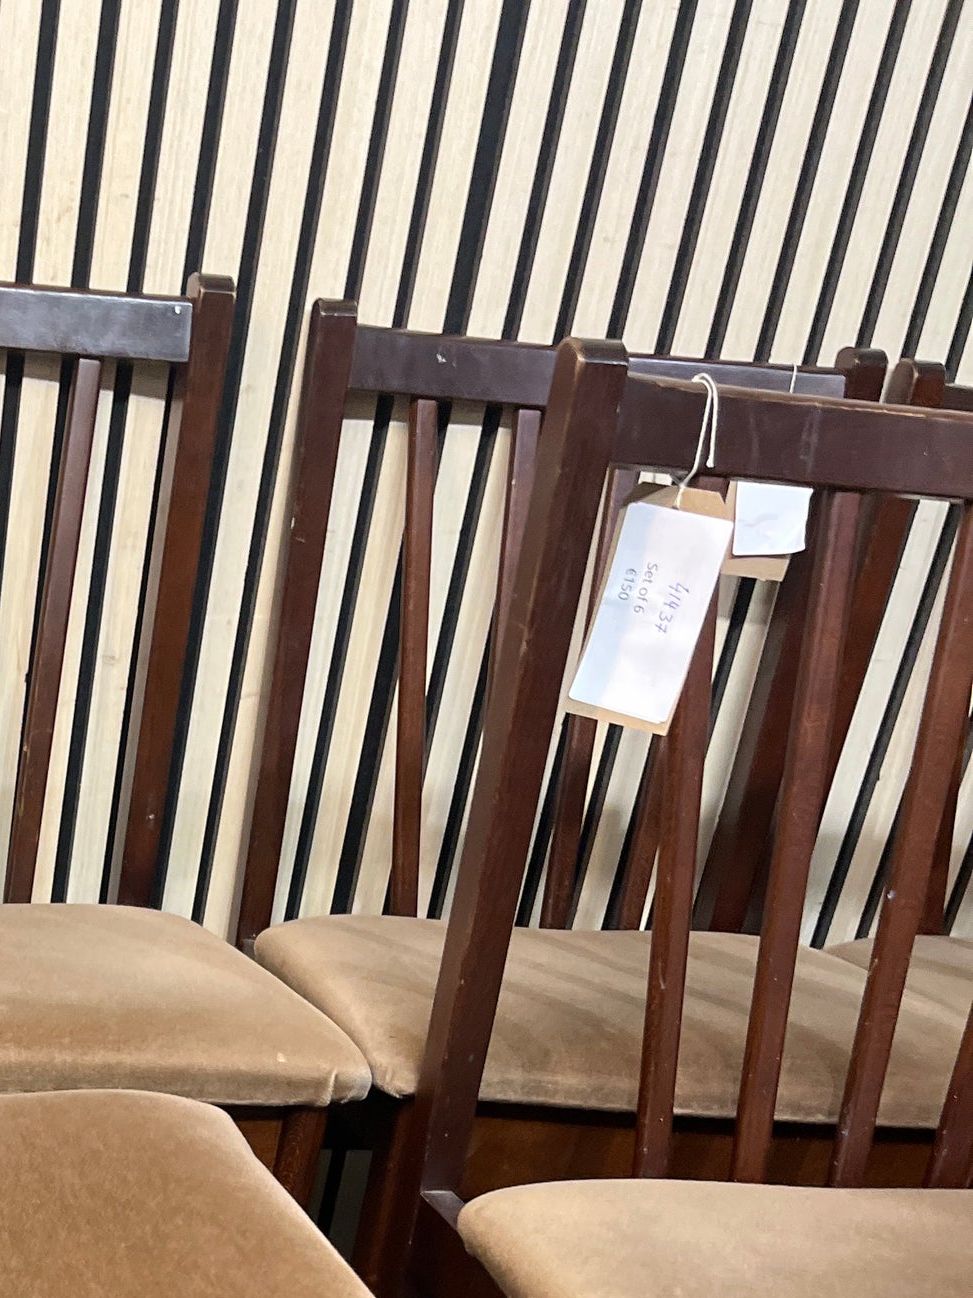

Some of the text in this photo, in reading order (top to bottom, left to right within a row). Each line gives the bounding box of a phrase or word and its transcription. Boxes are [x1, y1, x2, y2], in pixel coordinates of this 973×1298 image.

[633, 562, 658, 614] Set of 6
[654, 582, 690, 634] 41437
